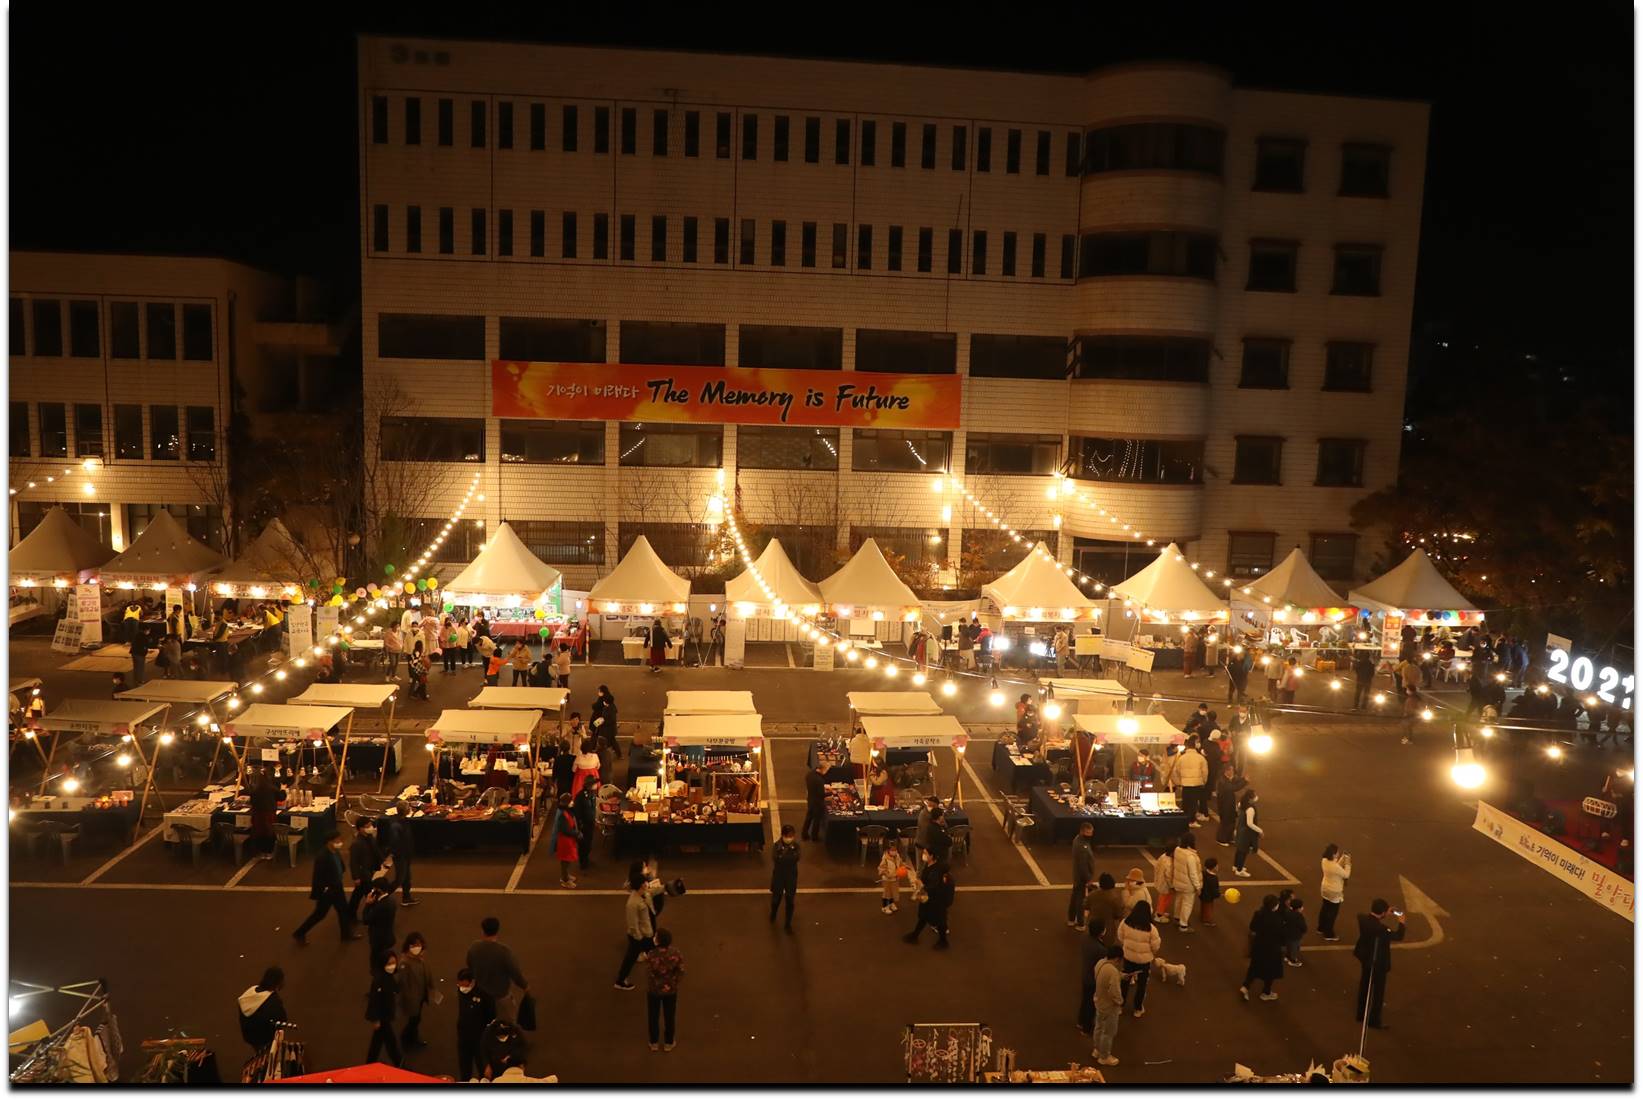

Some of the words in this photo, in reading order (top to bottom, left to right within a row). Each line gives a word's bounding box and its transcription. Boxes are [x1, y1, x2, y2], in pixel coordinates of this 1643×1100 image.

[546, 382, 588, 399] 기억이
[594, 384, 640, 399] 미래다
[647, 377, 689, 404] The
[700, 380, 794, 423] Memory
[805, 386, 824, 407] is
[836, 384, 910, 412] Future
[1536, 845, 1560, 865] 기억이
[1559, 858, 1586, 881] 미래다!
